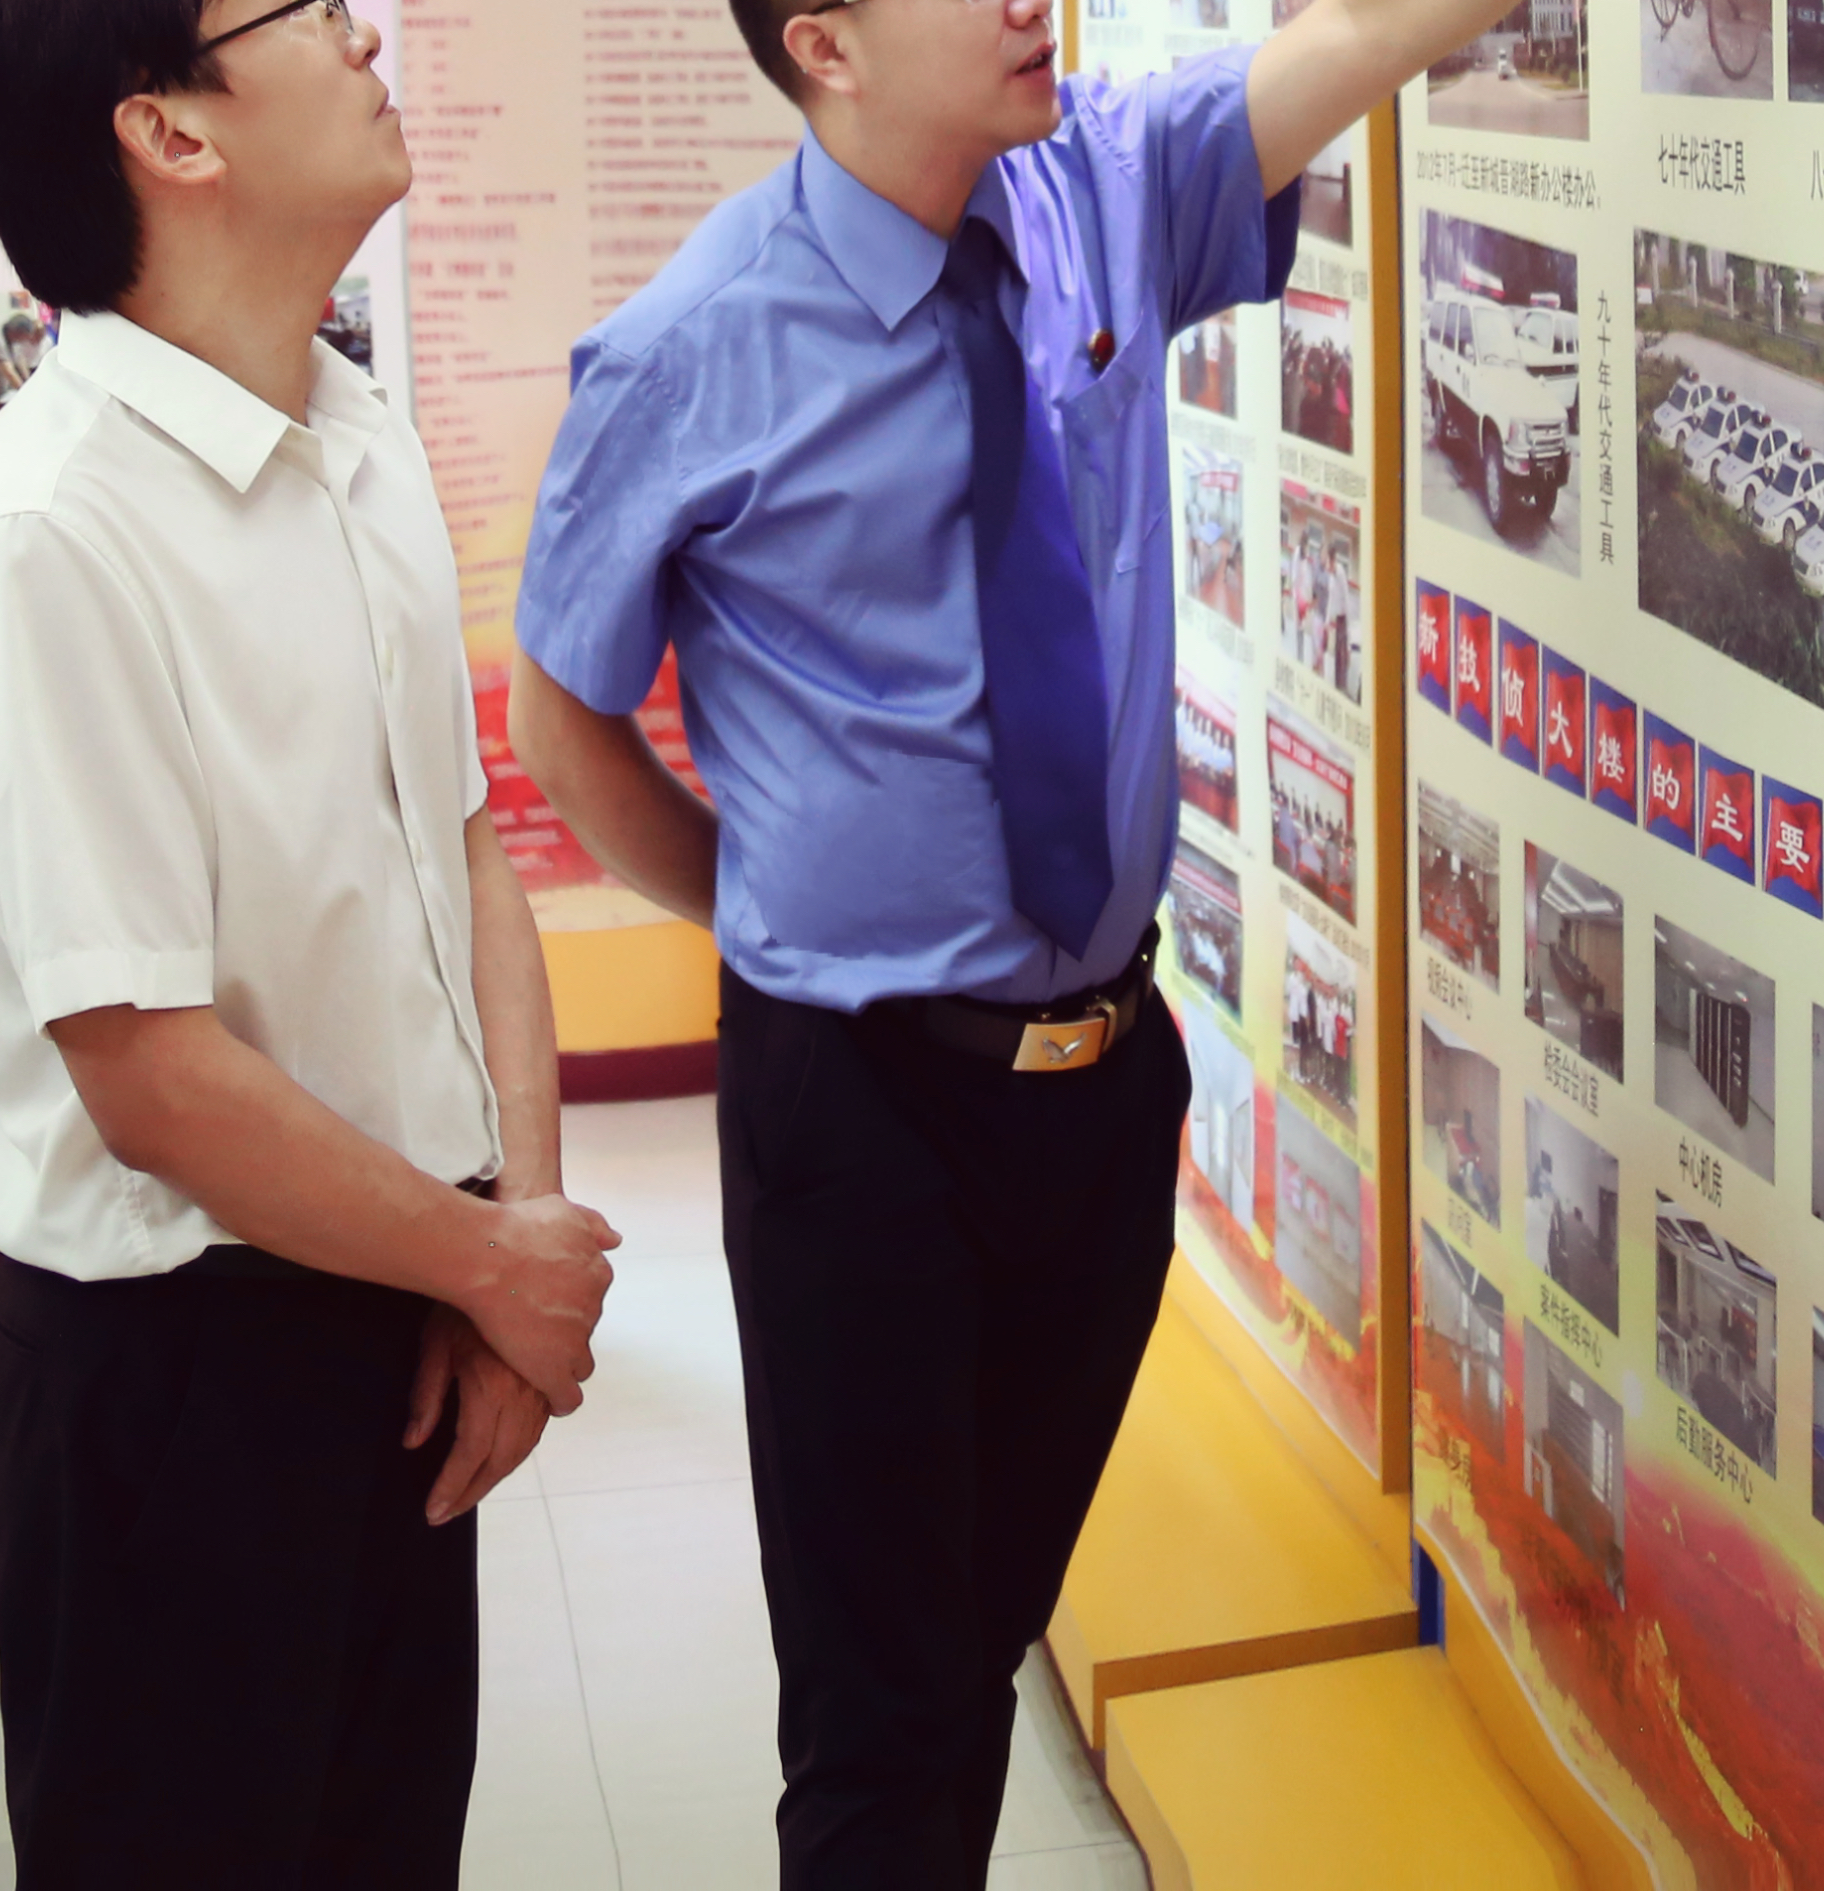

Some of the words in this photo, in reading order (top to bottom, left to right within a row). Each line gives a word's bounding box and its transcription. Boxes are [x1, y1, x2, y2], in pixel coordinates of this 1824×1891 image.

[1657, 134, 1746, 196] 七十年代交通工具
[1595, 289, 1615, 566] 九十年代交通工具
[1679, 1137, 1724, 1209] 中心机房
